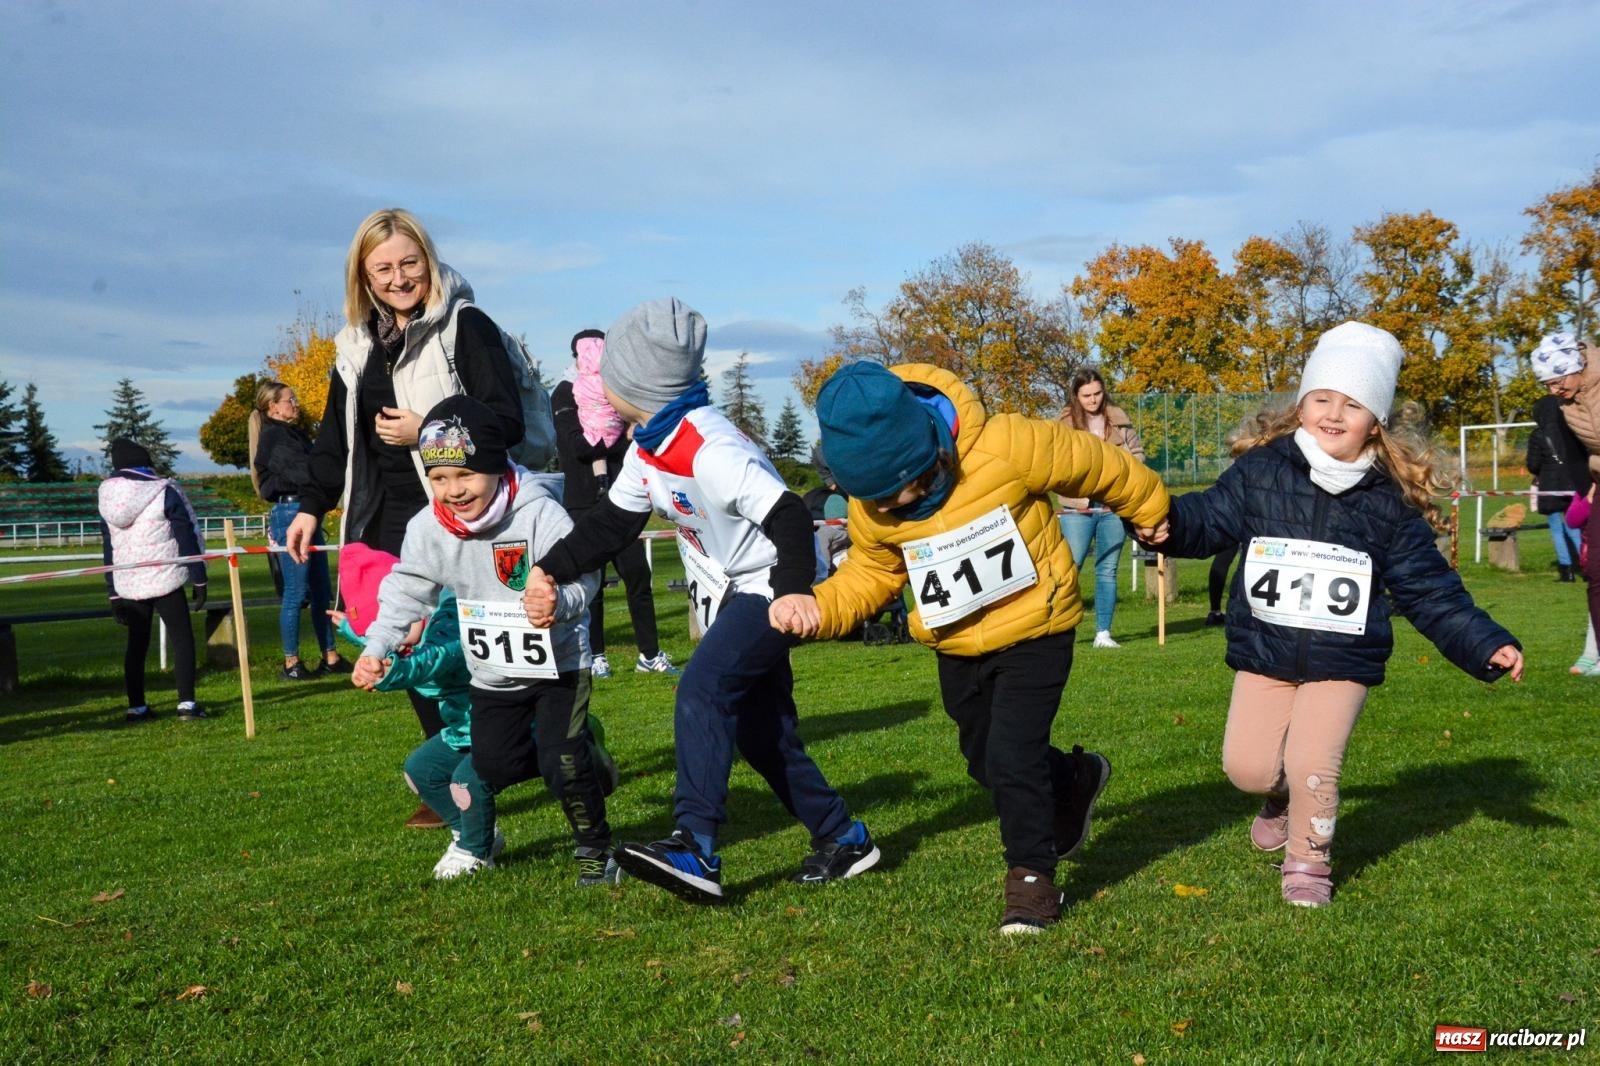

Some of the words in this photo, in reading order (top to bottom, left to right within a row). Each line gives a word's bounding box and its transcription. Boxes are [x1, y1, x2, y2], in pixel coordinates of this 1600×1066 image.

[936, 516, 1008, 552] www.personalbest.pl
[920, 538, 1015, 608] 417
[1291, 549, 1367, 566] www.personalbest.pl
[1250, 568, 1361, 617] 419
[489, 610, 528, 619] www.persona
[467, 627, 548, 666] 515
